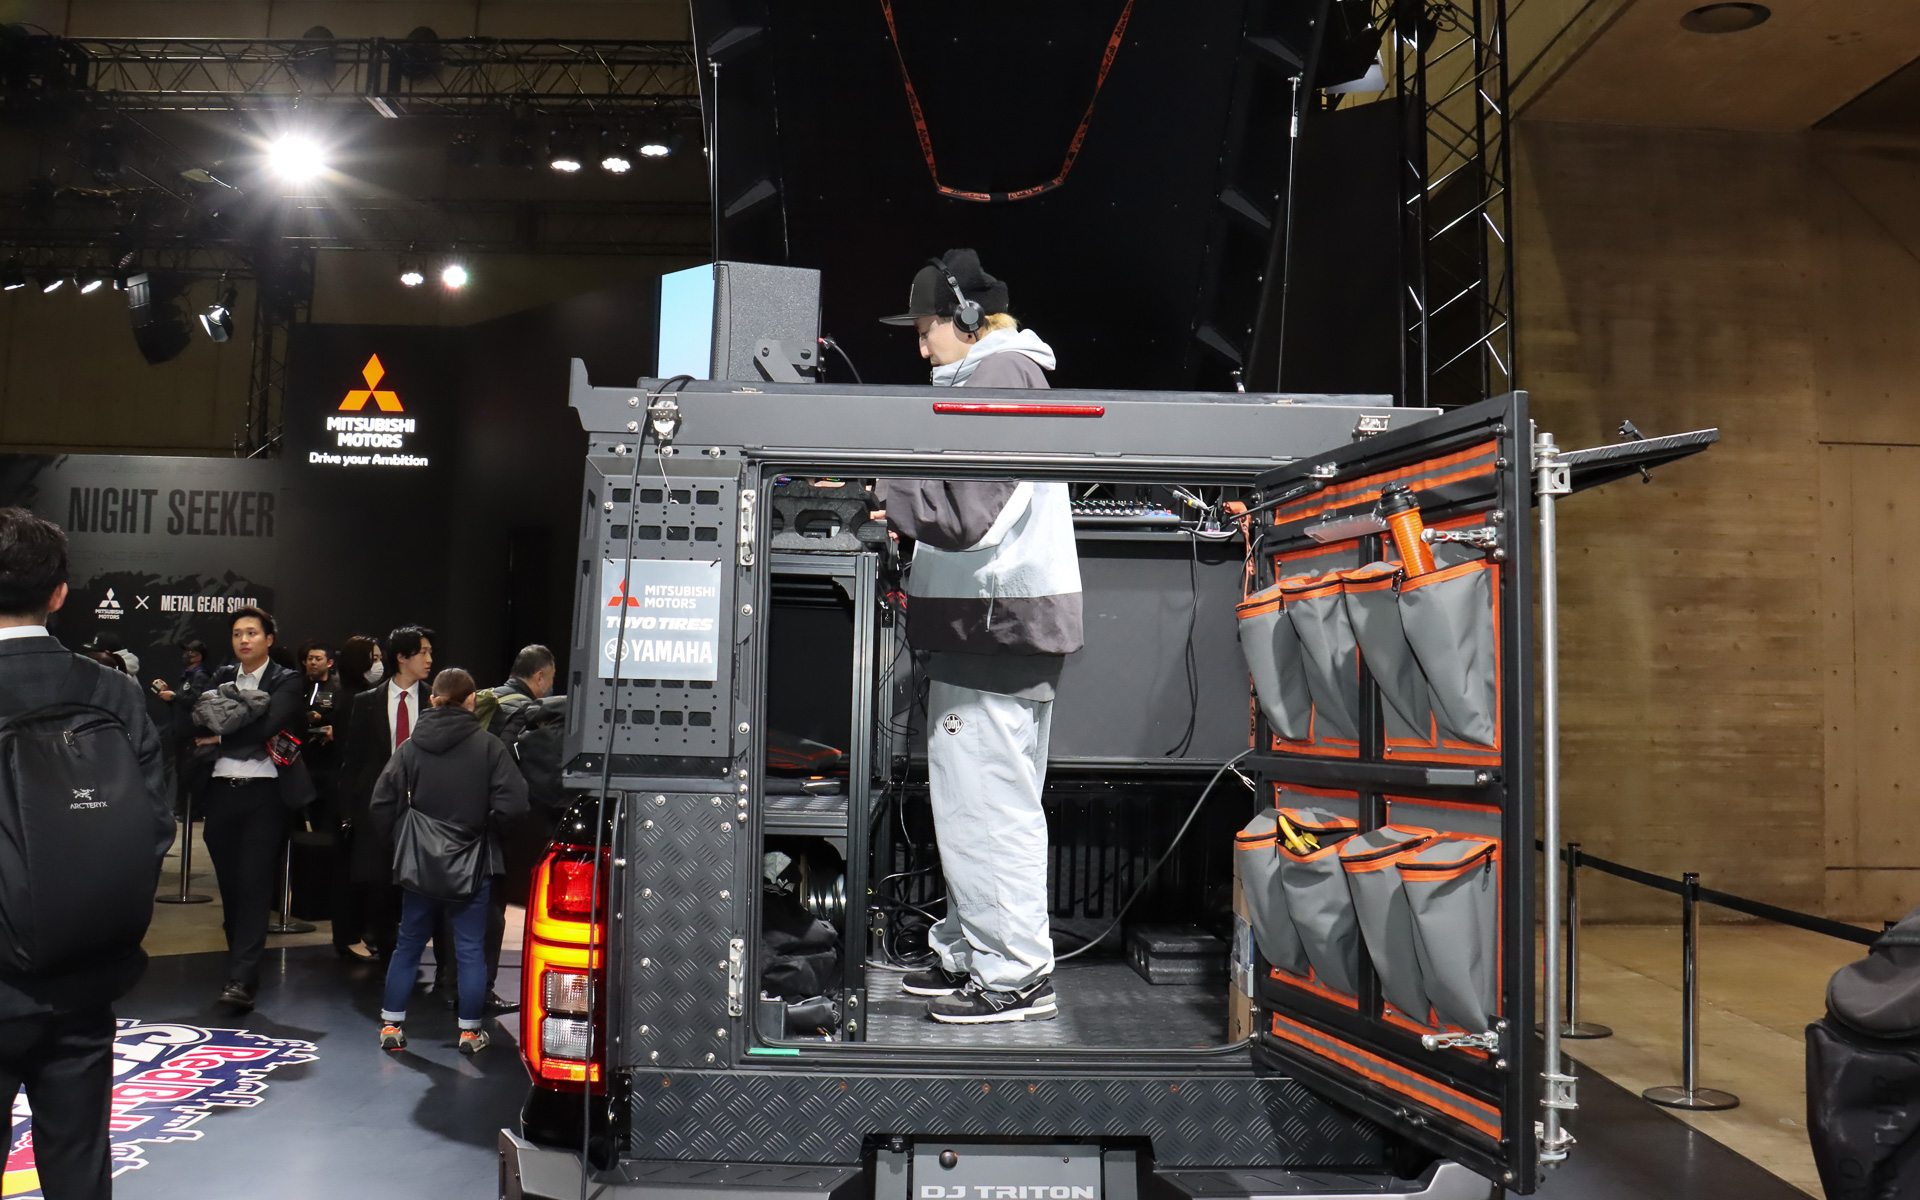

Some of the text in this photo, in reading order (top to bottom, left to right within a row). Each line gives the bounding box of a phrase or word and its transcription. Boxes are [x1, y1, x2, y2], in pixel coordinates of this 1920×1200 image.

[327, 416, 416, 433] MITSUBISHI
[337, 432, 403, 449] MOTORS
[309, 452, 429, 467] Drive your Ambition
[68, 487, 276, 537] NIGHT SEEKER
[644, 585, 716, 598] MITSUBISHI
[160, 594, 194, 612] METAL
[197, 595, 225, 613] GEAR
[644, 598, 697, 609] MOTORS
[605, 615, 714, 632] TOYO TIRES
[631, 639, 713, 664] YAMAHA
[920, 1184, 1094, 1200] DJ TRITON
